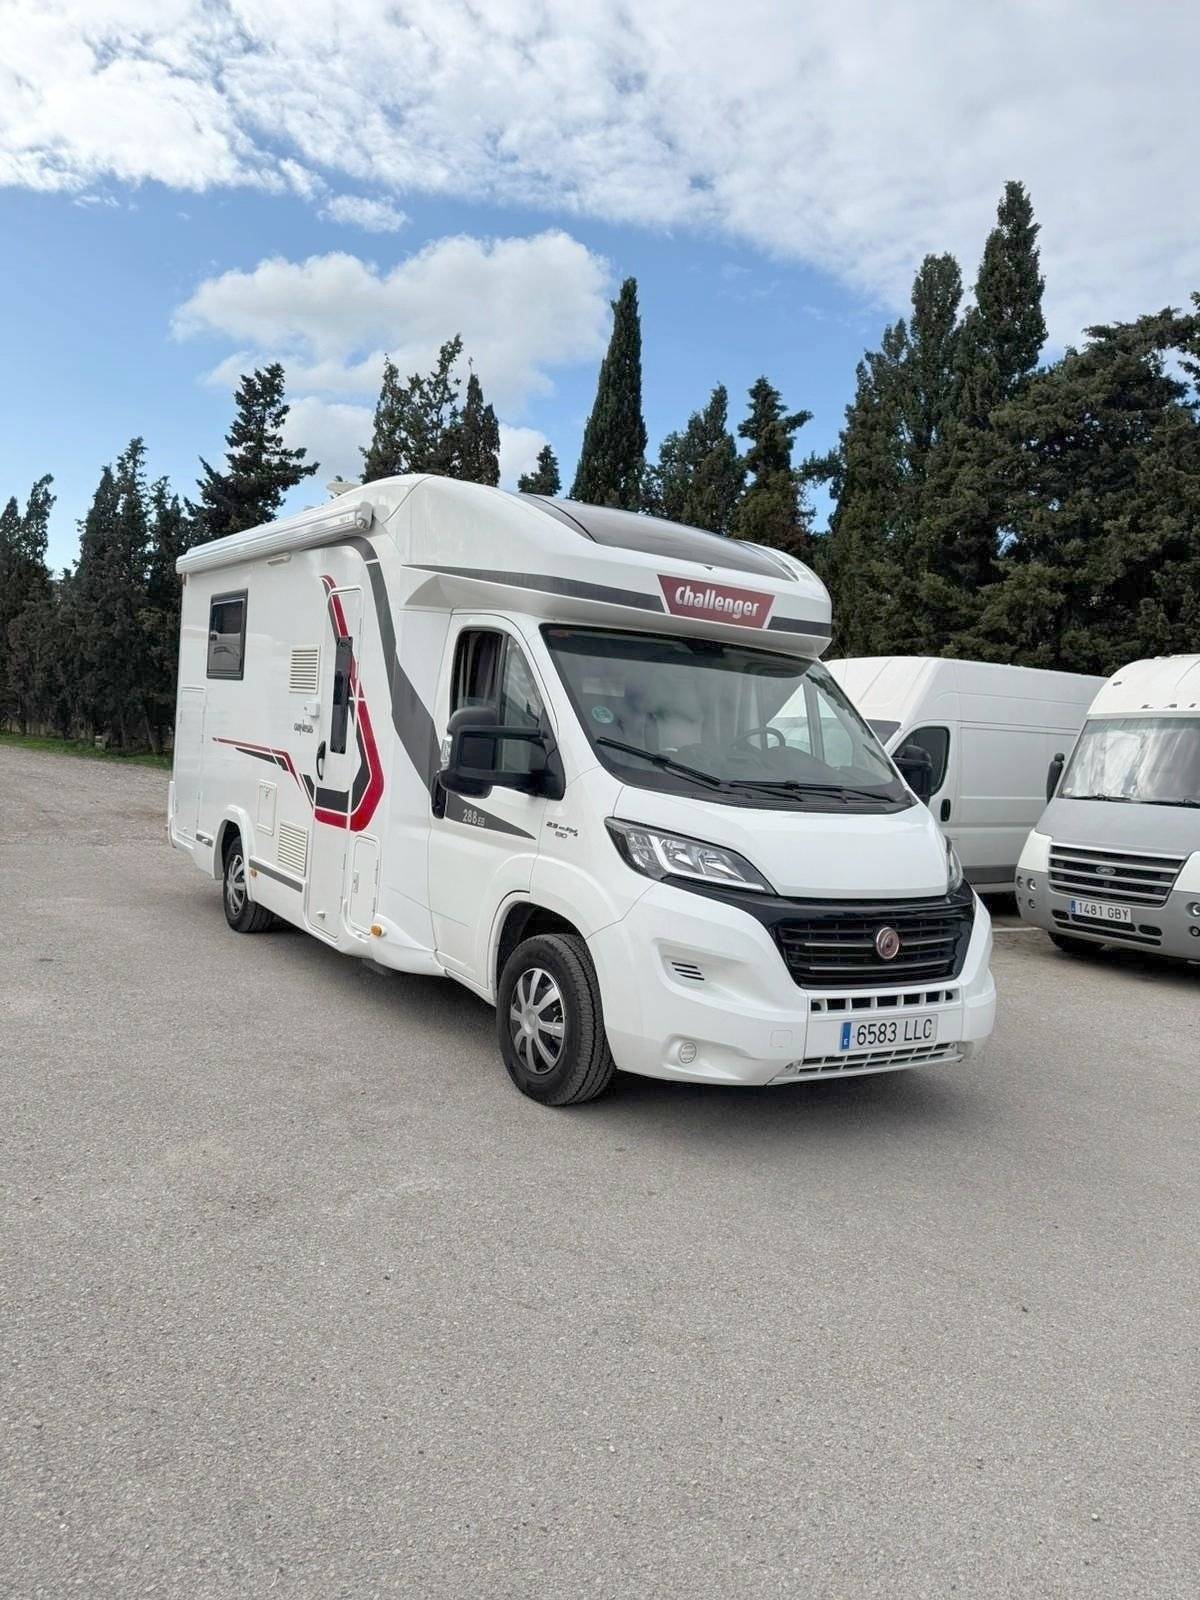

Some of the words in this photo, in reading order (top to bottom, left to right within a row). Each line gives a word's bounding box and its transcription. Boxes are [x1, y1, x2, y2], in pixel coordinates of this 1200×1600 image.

[675, 585, 760, 619] Challenger
[1078, 902, 1103, 916] 1481
[1107, 907, 1129, 920] GBY
[856, 1021, 898, 1046] 6583
[903, 1018, 933, 1042] LLC
